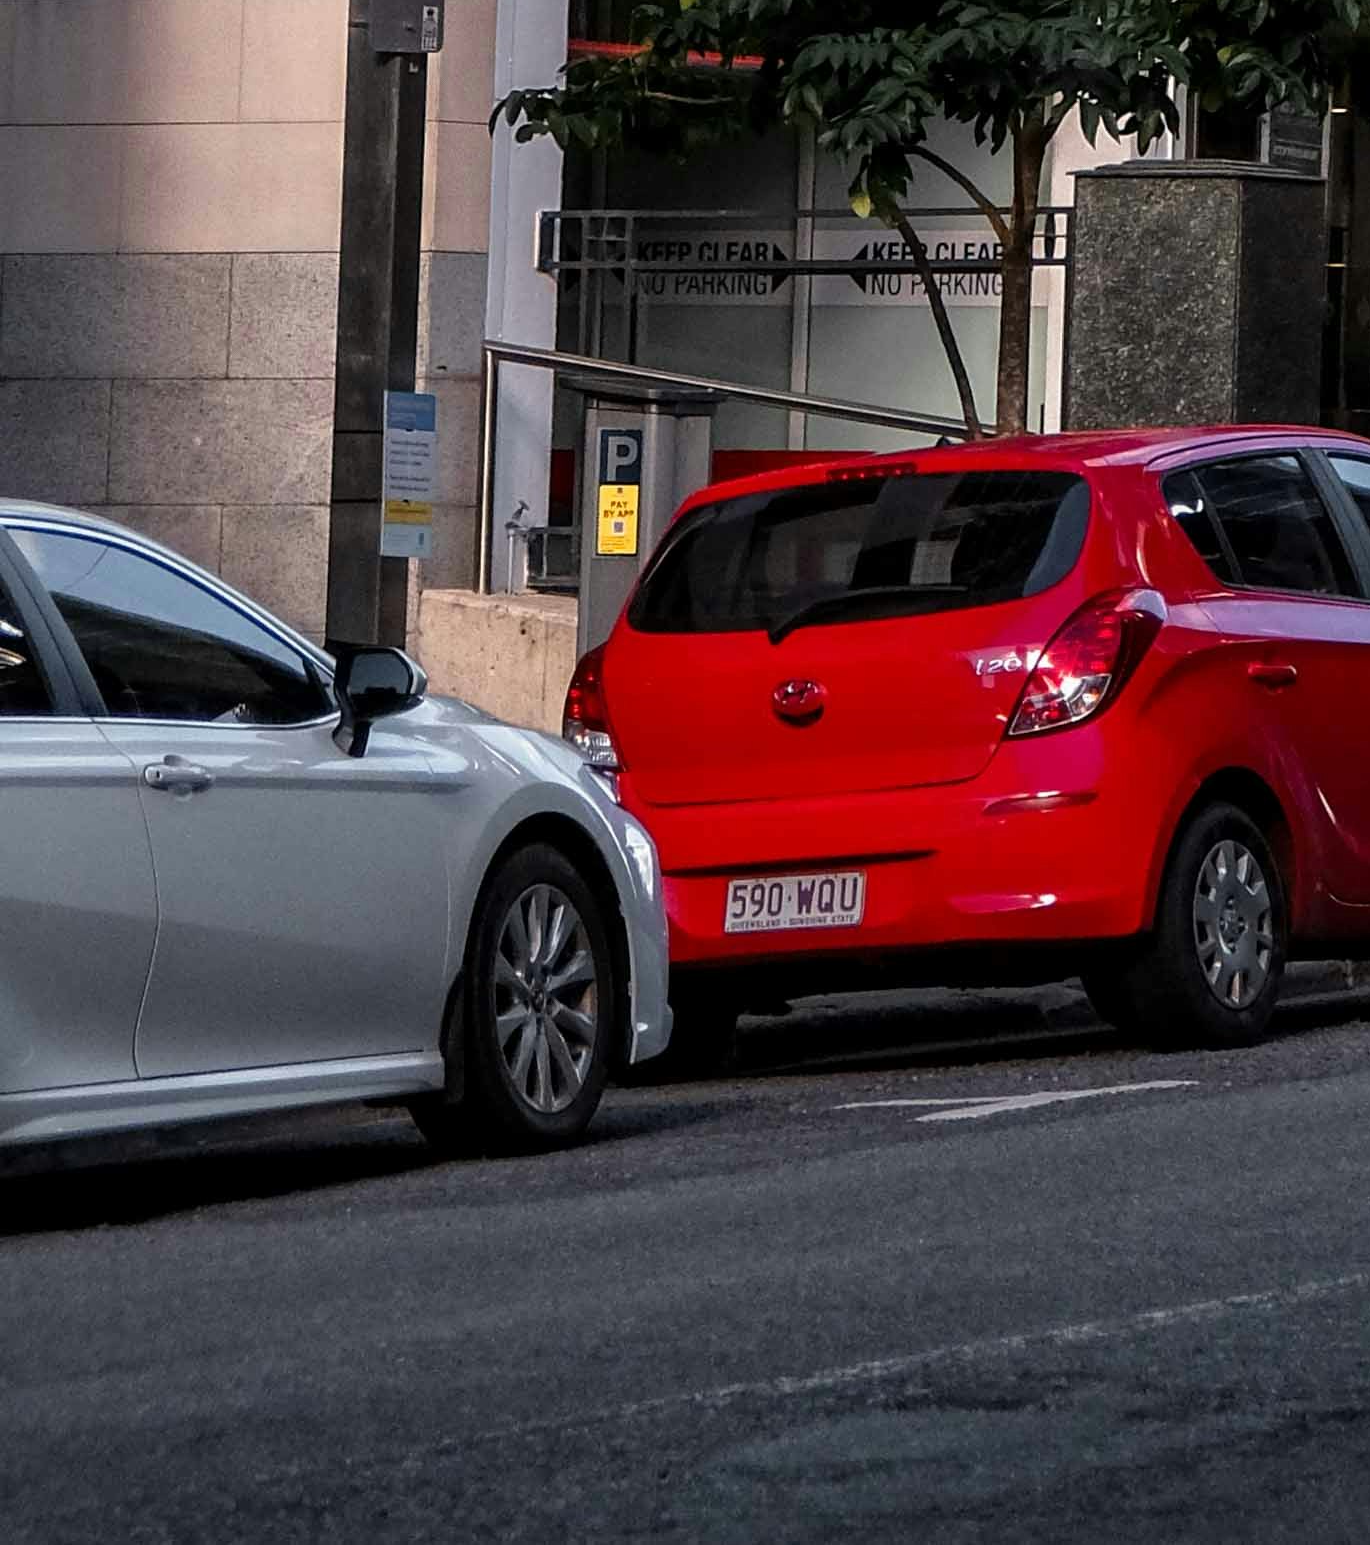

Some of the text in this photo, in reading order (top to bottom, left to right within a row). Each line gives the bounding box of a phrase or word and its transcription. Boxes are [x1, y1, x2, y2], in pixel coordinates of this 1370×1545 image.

[674, 272, 769, 297] PARKING
[871, 273, 902, 296] NO
[606, 435, 639, 482] P
[603, 509, 616, 518] BY
[610, 500, 629, 509] PAY
